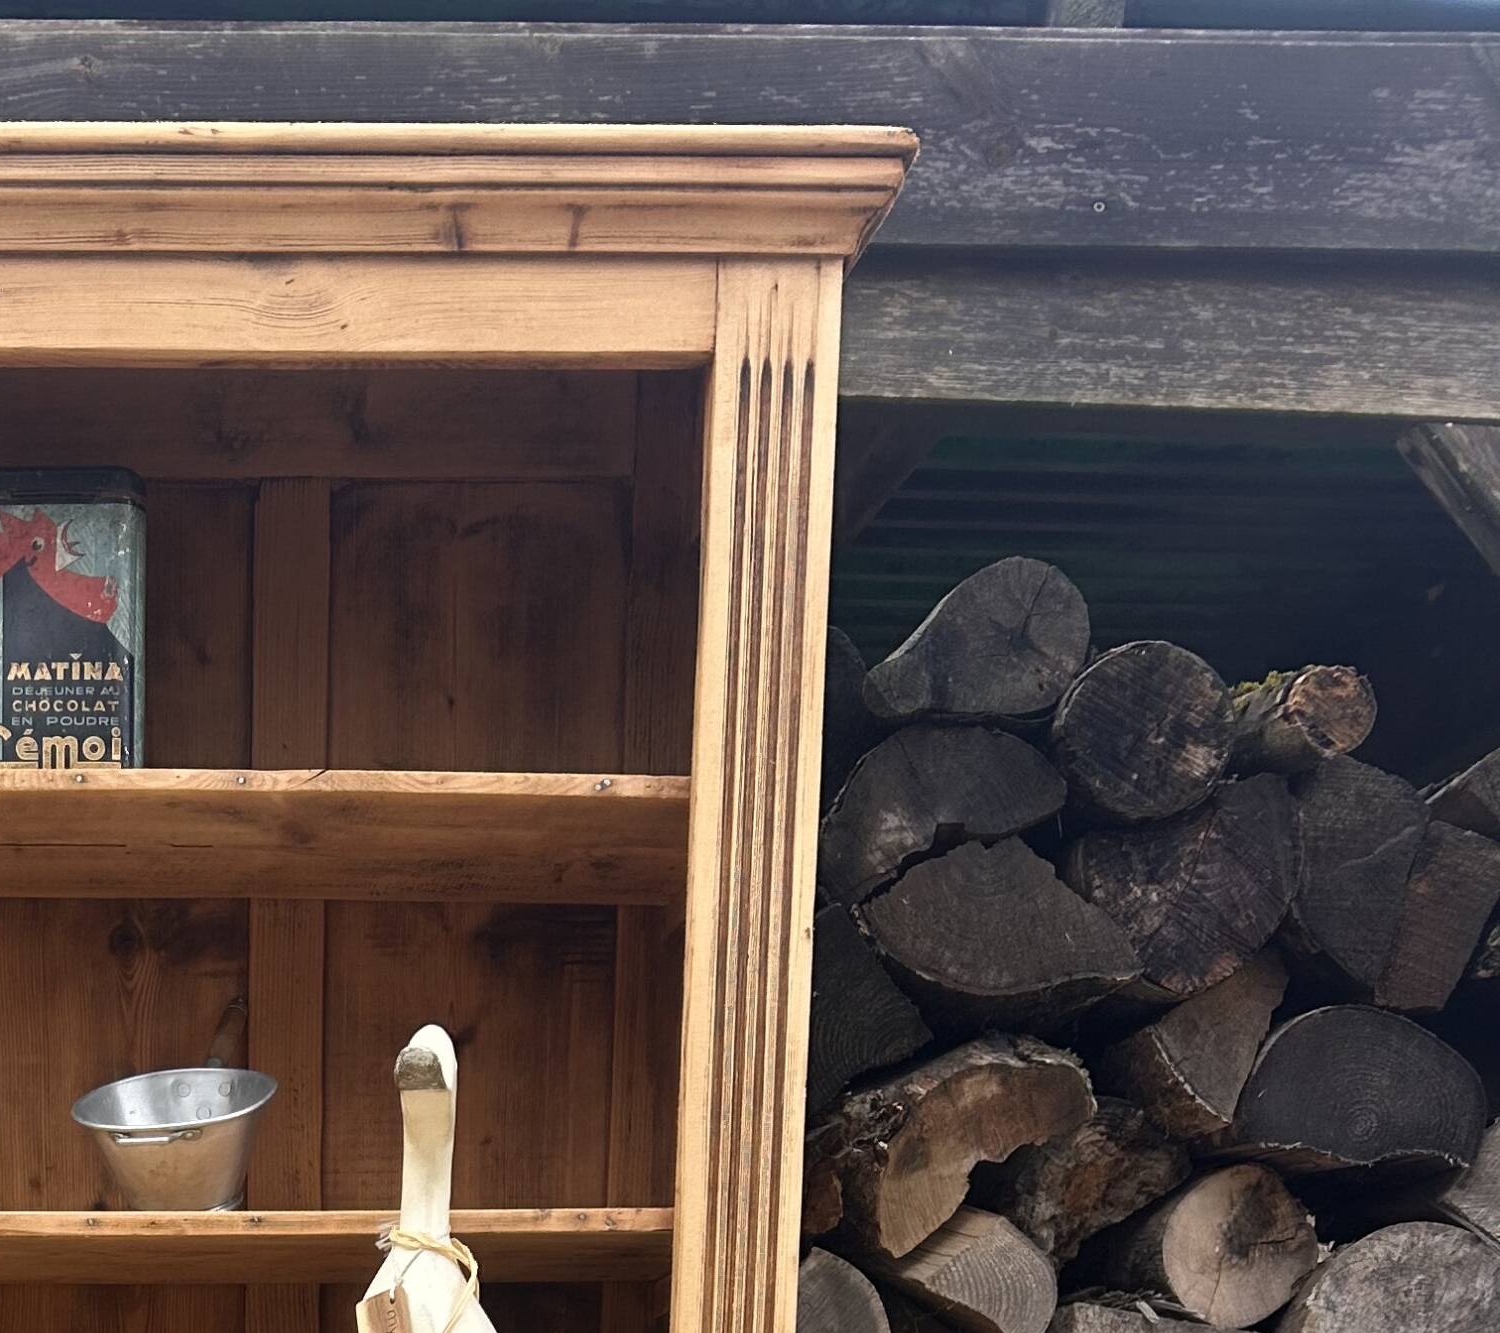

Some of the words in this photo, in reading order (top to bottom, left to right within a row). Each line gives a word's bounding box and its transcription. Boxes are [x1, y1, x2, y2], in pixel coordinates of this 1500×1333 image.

[7, 653, 124, 681] MATINA
[101, 686, 120, 696] AU
[12, 700, 120, 712] CHOCOLAT
[11, 716, 34, 727] EN
[46, 716, 120, 727] POUDRE
